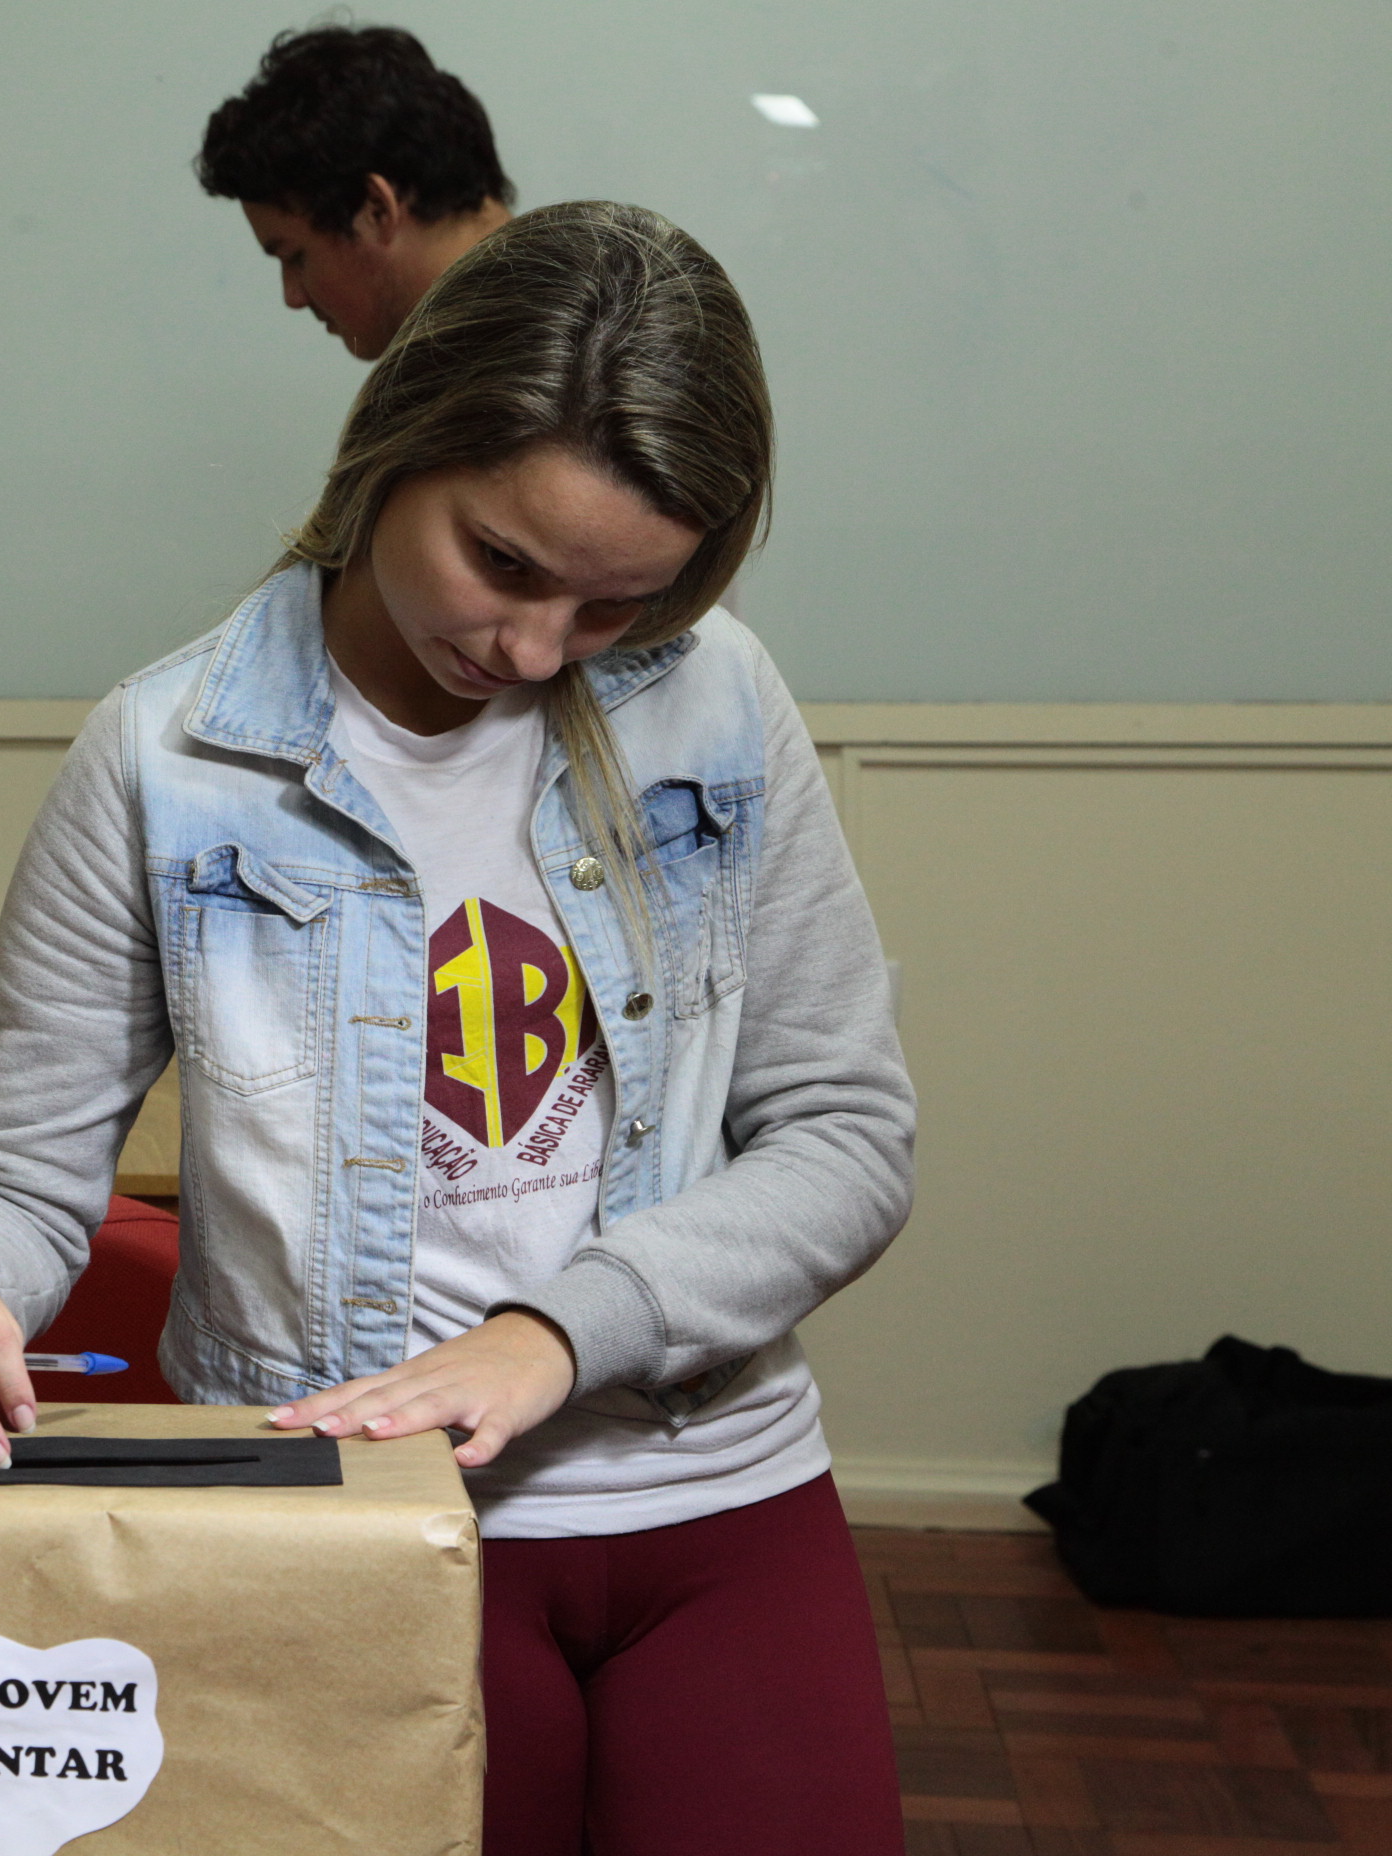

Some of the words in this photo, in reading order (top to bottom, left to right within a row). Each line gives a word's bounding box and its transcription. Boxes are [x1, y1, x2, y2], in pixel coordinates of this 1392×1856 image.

[516, 1115, 572, 1167] BÁSICA
[550, 1093, 585, 1117] DE
[433, 1183, 508, 1209] Conhecimento
[511, 1174, 556, 1203] Garante
[559, 1171, 579, 1187] sua
[581, 1158, 604, 1183] Libe
